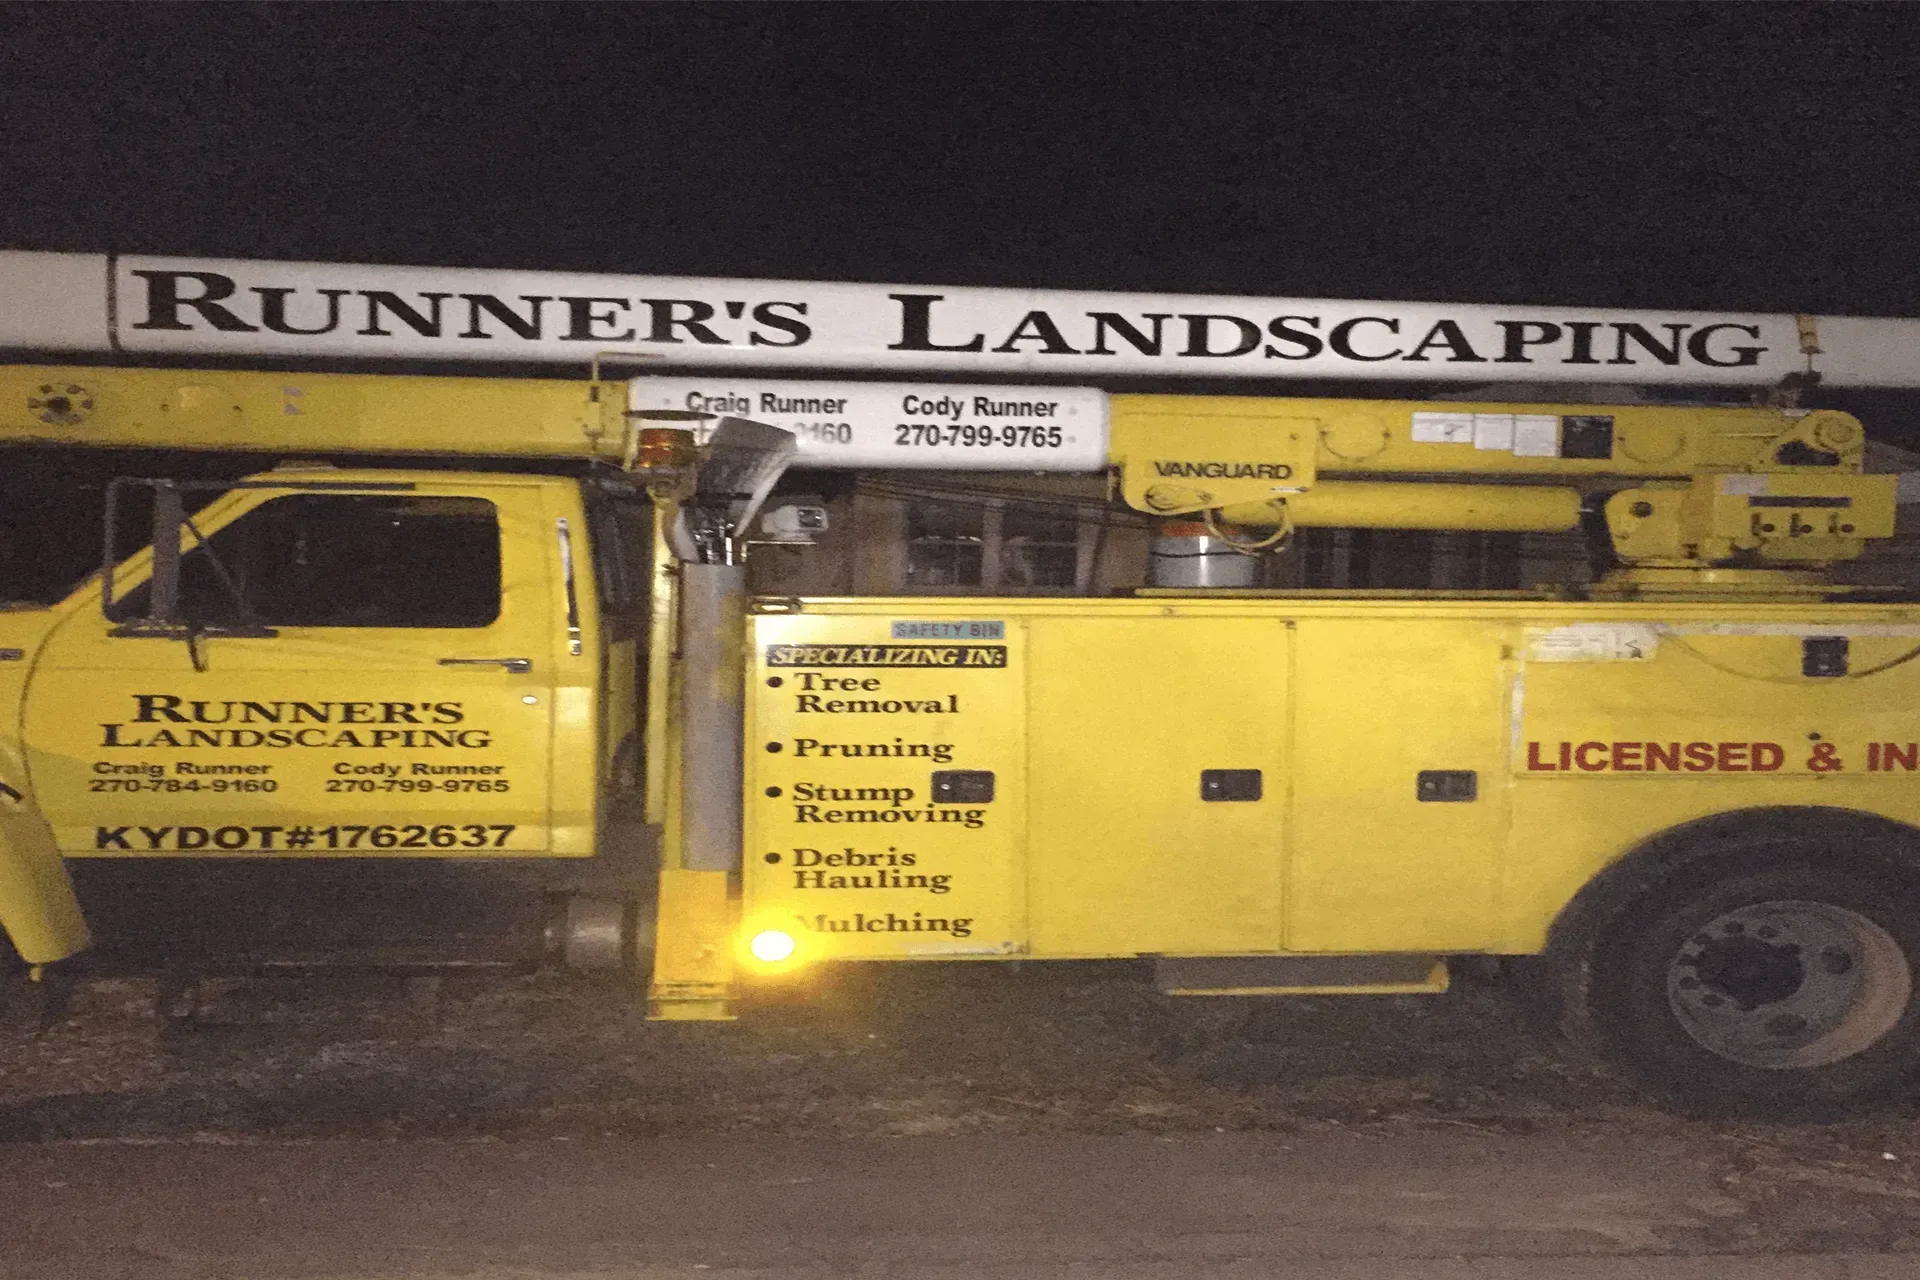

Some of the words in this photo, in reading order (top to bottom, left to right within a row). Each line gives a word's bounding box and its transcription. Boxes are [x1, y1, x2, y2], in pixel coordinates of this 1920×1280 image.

[132, 270, 811, 346] RUNNER'S
[887, 292, 1768, 369] LANDSCAPING
[685, 391, 749, 415] Craig
[760, 392, 847, 414] Runner
[902, 395, 963, 420] Cody
[973, 396, 1058, 417] Runner
[895, 423, 1063, 448] 270-799-9765
[1155, 461, 1293, 480] VANGUARD
[894, 623, 963, 637] SAFETY
[970, 623, 1001, 637] BIN
[772, 648, 959, 665] SPECIALIZING
[963, 648, 1003, 665] IN:
[794, 672, 881, 691] Tree
[131, 694, 464, 724] RUNNER'S
[795, 694, 960, 714] Removal
[99, 724, 494, 748] LANDSCAPING
[793, 737, 955, 763] Pruning
[1527, 741, 1785, 772] LICENSED
[1806, 741, 1843, 773] &
[92, 761, 165, 778] Craig
[175, 762, 273, 775] Runner
[333, 762, 400, 779] Cody
[411, 762, 506, 776] Runner
[89, 779, 278, 793] 270-784-9160
[326, 779, 511, 793] 270-799-9765
[793, 782, 915, 807] Stump
[794, 803, 987, 829] Removing
[95, 824, 517, 850] KYDOT#1762637
[793, 847, 917, 867] Debris
[793, 869, 952, 894] Hauling
[795, 912, 974, 938] Mulching
